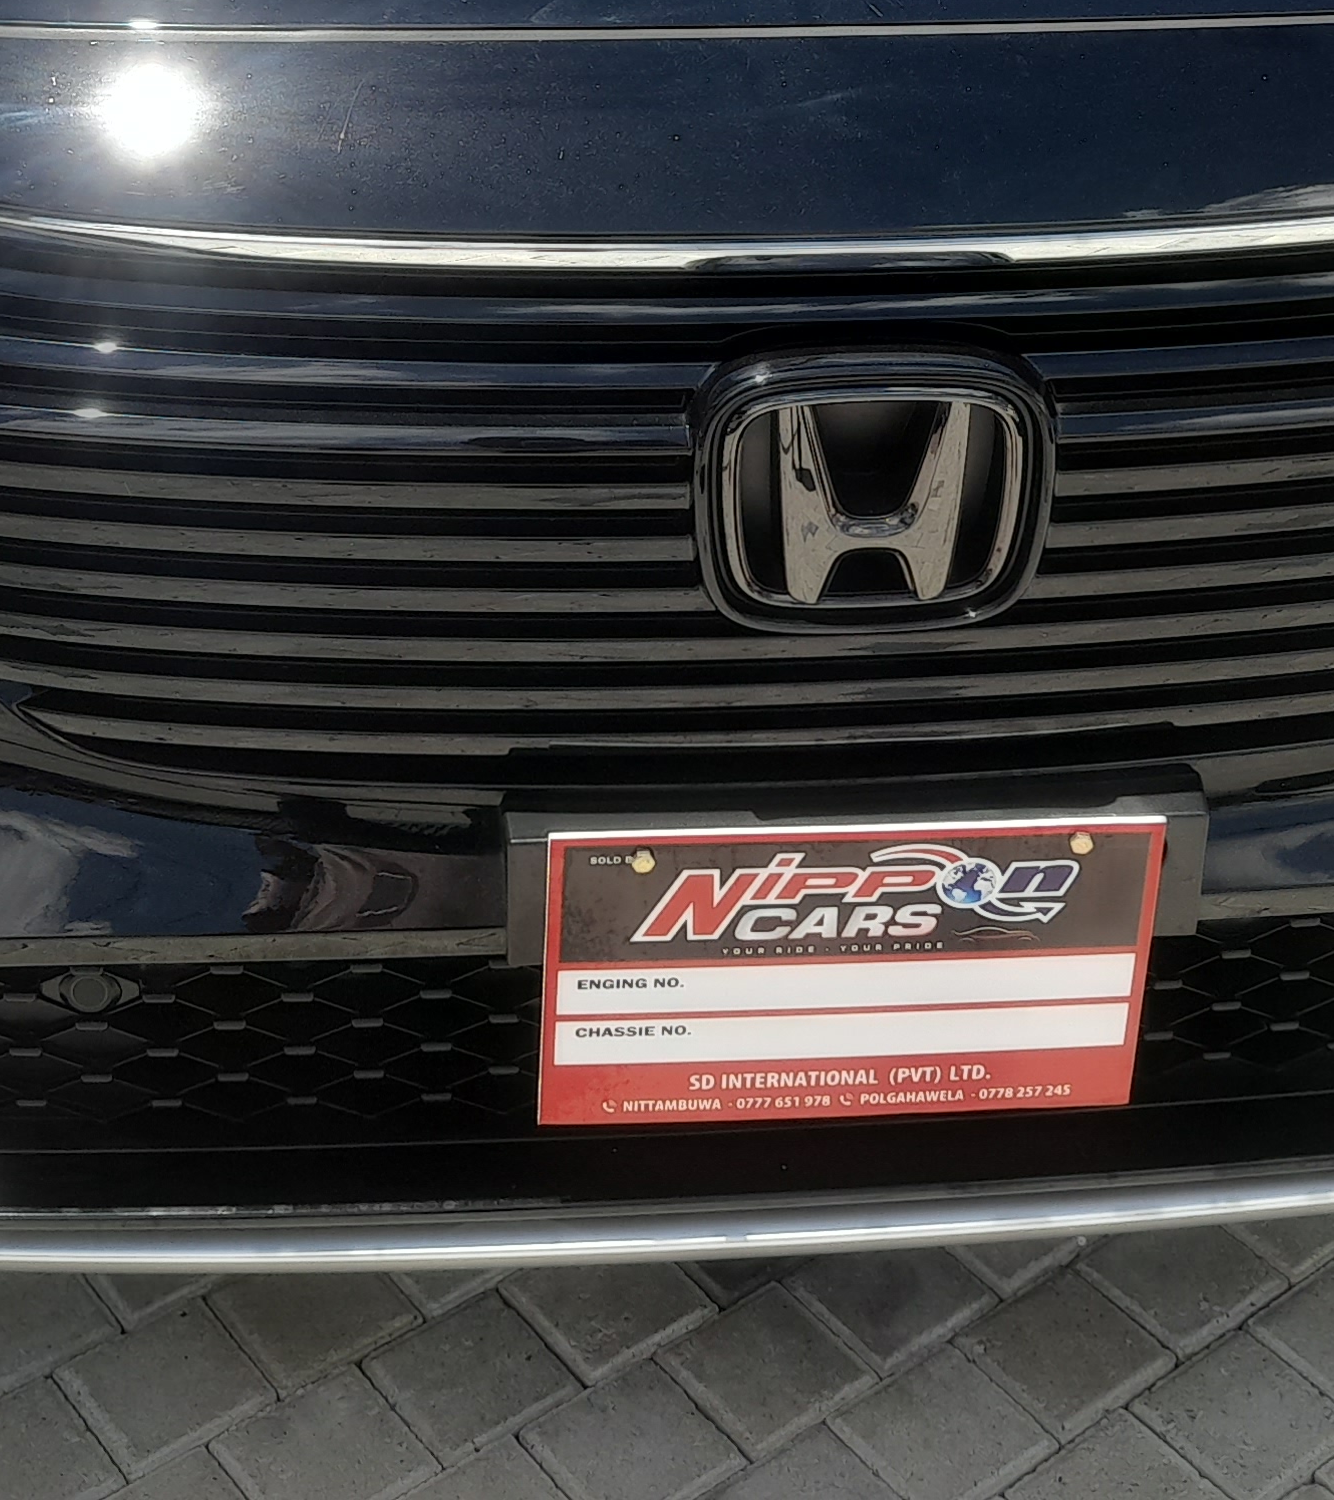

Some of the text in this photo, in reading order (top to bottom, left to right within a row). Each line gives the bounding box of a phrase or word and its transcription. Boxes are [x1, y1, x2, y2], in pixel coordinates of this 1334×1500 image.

[590, 855, 622, 865] SOLD
[734, 902, 943, 941] CARS
[722, 941, 944, 956] YOUR RIDE YOUR PRIDE
[577, 977, 685, 990] ENGING NO.
[575, 1025, 692, 1038] CHASSIE NO.
[688, 1064, 992, 1090] SD INTERNATIONAL (PVT) LTD.
[623, 1098, 722, 1112] NITTAMBUWA
[736, 1097, 772, 1109] 0777
[774, 1096, 800, 1108] 651
[804, 1095, 831, 1107] 978
[859, 1089, 964, 1105] POLGAHAWELA
[979, 1087, 1014, 1099] 0778
[1016, 1085, 1042, 1098] 257
[1045, 1084, 1072, 1096] 245
